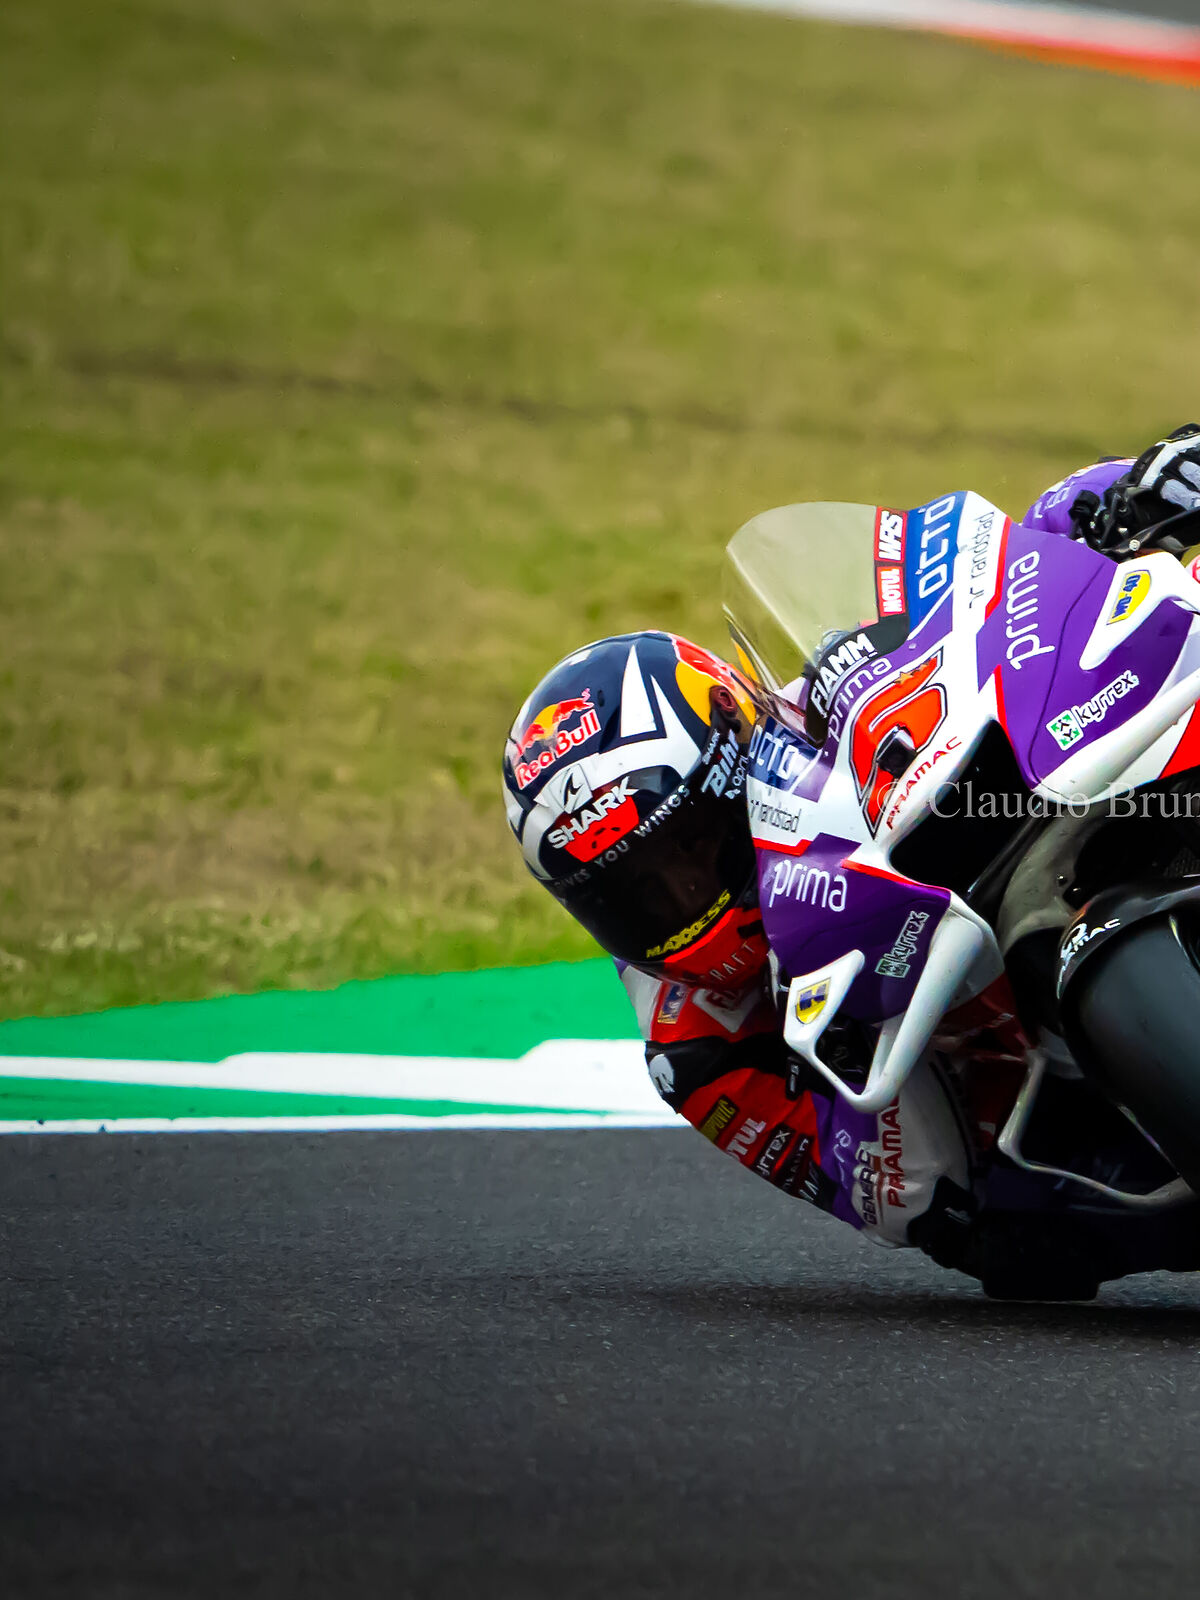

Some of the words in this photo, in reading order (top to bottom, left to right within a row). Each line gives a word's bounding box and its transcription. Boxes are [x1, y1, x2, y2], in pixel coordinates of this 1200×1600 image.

[878, 510, 903, 561] WRS
[915, 496, 956, 599] OCTO
[968, 511, 995, 579] randstad
[880, 568, 903, 613] MOTUL
[1006, 550, 1055, 670] prima
[811, 633, 878, 714] FIAMM
[828, 658, 893, 743] prima
[1073, 669, 1140, 728] kyrrex
[556, 708, 601, 758] Bull
[547, 776, 640, 849] SHARK
[886, 736, 962, 830] PRAMAC
[594, 840, 630, 868] YOU
[634, 785, 690, 837] WINGS
[769, 859, 848, 912] prima
